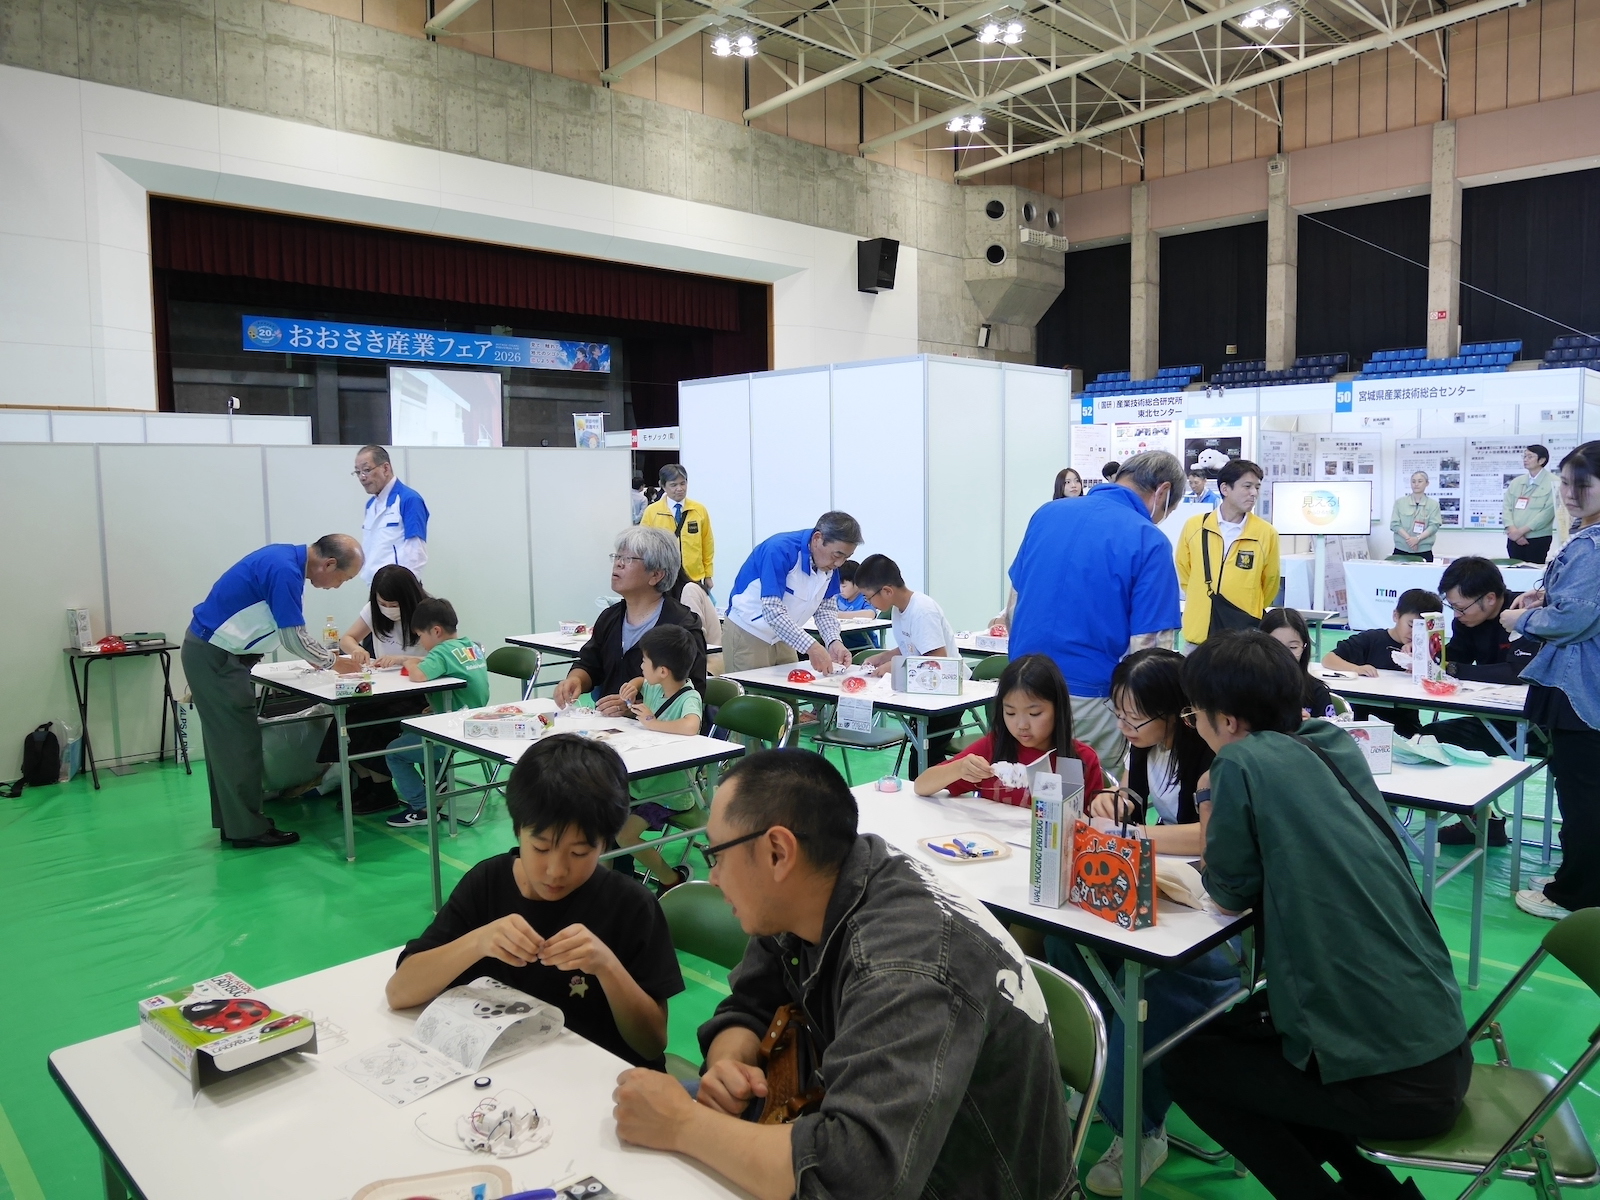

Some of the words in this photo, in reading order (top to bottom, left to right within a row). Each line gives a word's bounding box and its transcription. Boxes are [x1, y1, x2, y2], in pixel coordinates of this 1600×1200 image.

[289, 324, 493, 360] おおさき産業フェア
[494, 350, 521, 362] 2026
[1337, 391, 1352, 403] 50
[1358, 385, 1476, 402] 宮城県産業技術総合センター
[1081, 405, 1093, 417] 52
[1137, 409, 1183, 418] 東北センター
[1375, 588, 1397, 598] ITIM
[1035, 819, 1044, 852] LADYBUG
[1033, 852, 1043, 903] WALL-HUGGING
